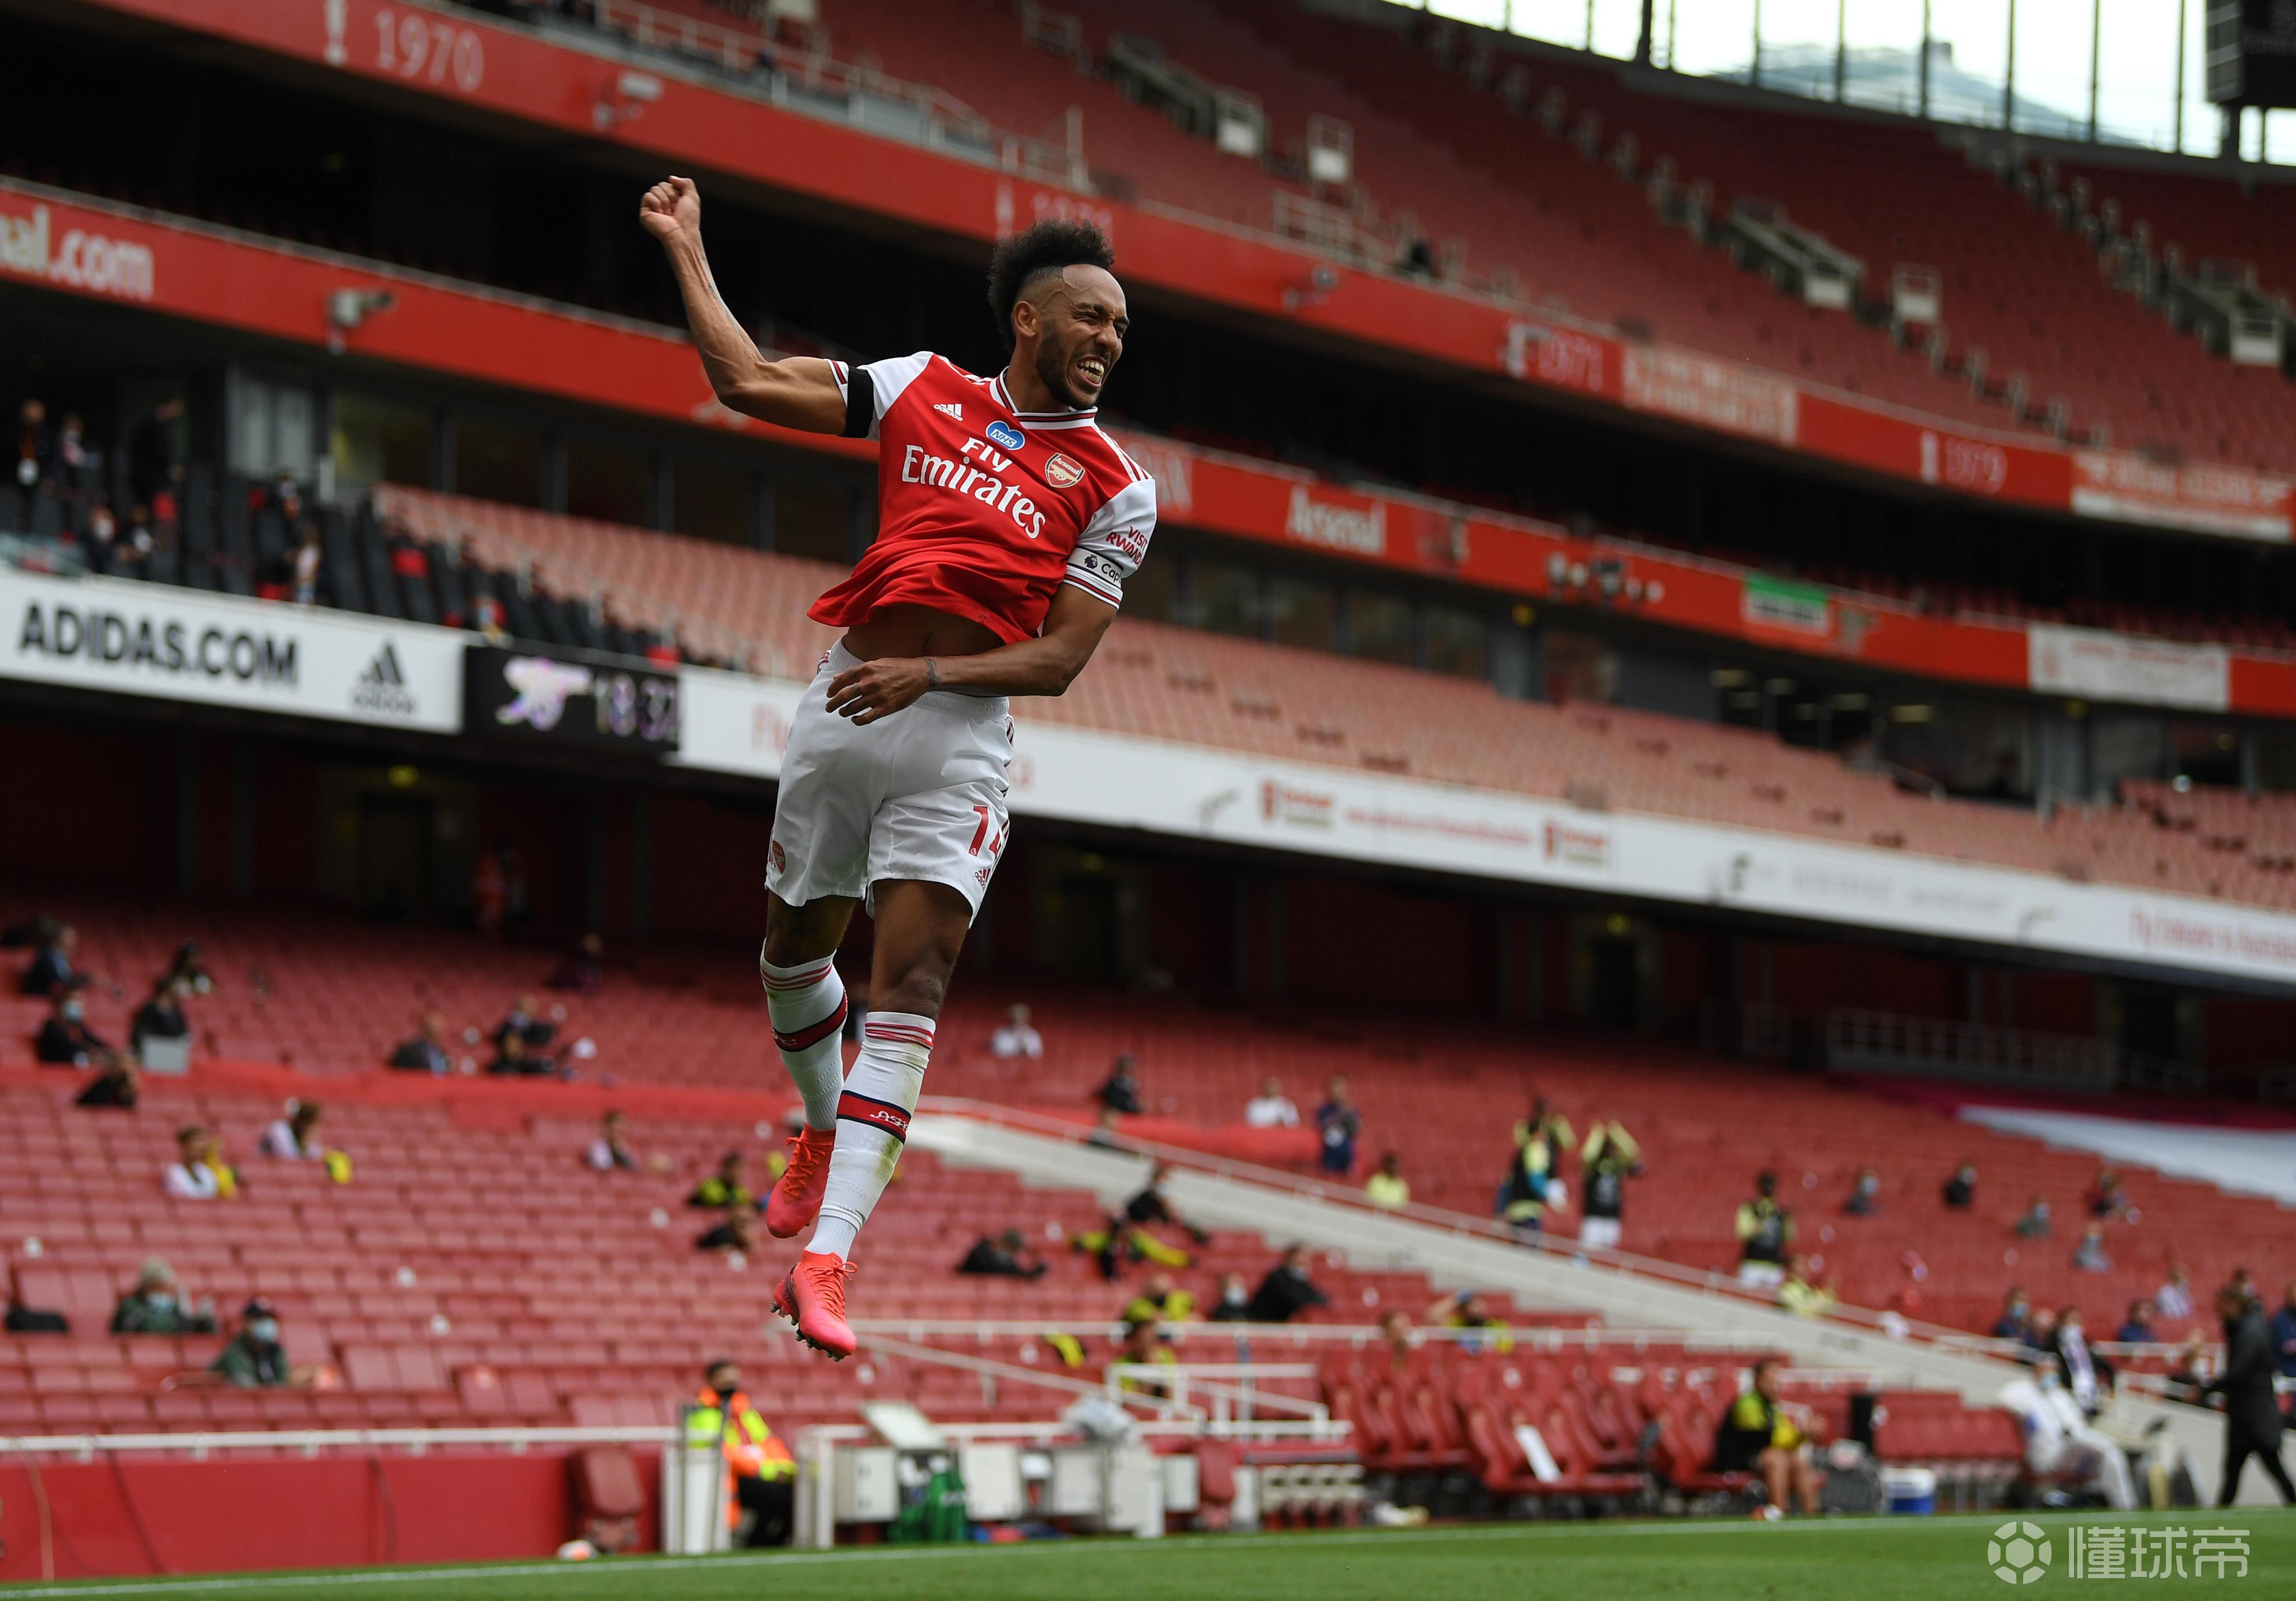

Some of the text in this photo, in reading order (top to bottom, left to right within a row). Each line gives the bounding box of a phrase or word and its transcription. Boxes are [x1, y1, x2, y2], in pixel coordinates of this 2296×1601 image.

[373, 9, 484, 92] 1970
[0, 203, 154, 300] al.com
[933, 404, 964, 422] adidas
[960, 437, 1012, 473] Fly
[990, 430, 1016, 447] NHS
[1055, 457, 1080, 475] Arsenal
[902, 444, 1046, 539] Emirates
[1285, 485, 1387, 553] Arsenal
[1105, 531, 1142, 567] RWAND
[1128, 525, 1148, 551] VISIT
[19, 601, 297, 687] ADIDAS.COM
